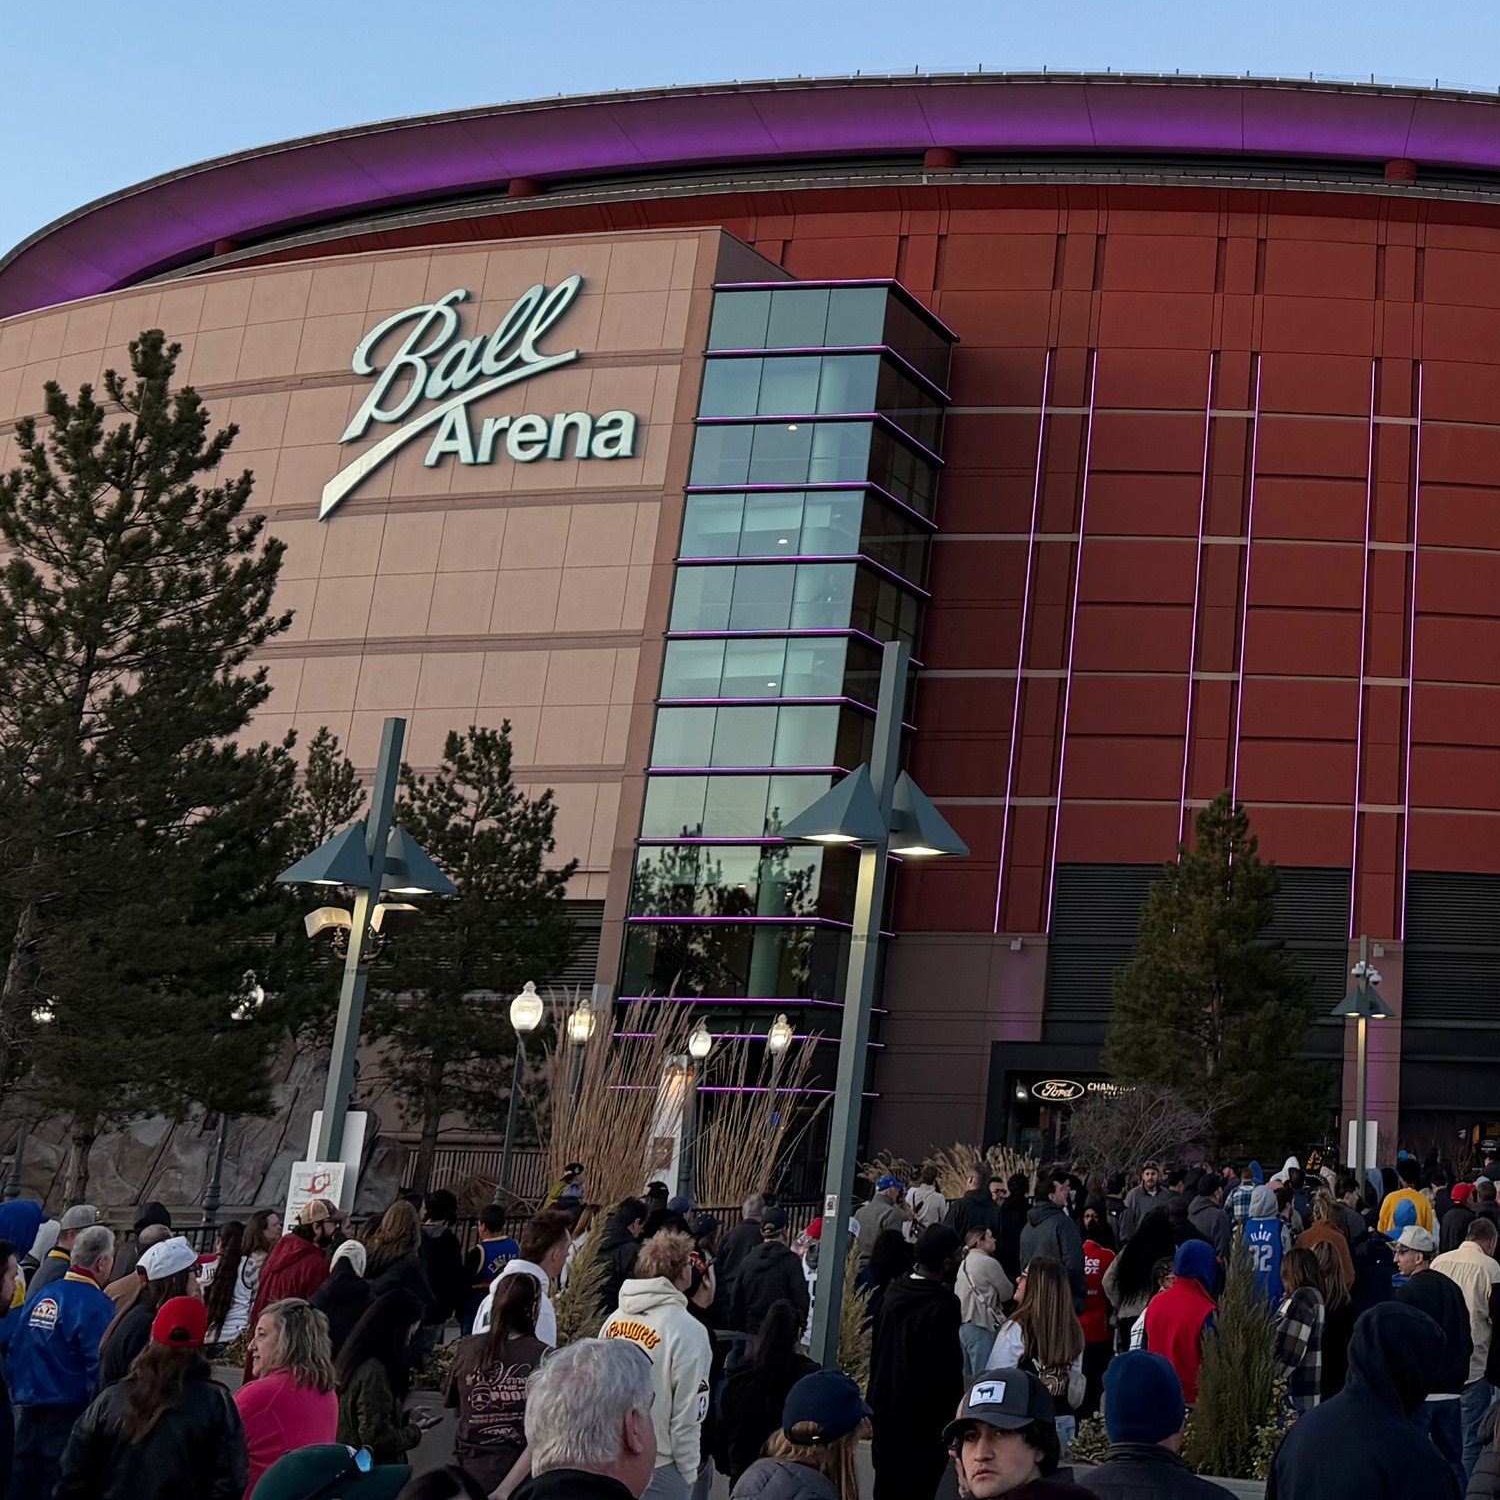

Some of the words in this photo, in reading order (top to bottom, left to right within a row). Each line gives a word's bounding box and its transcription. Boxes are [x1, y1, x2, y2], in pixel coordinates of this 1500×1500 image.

[318, 274, 582, 522] Ball
[423, 403, 637, 467] Arena
[1041, 1082, 1075, 1098] Ford
